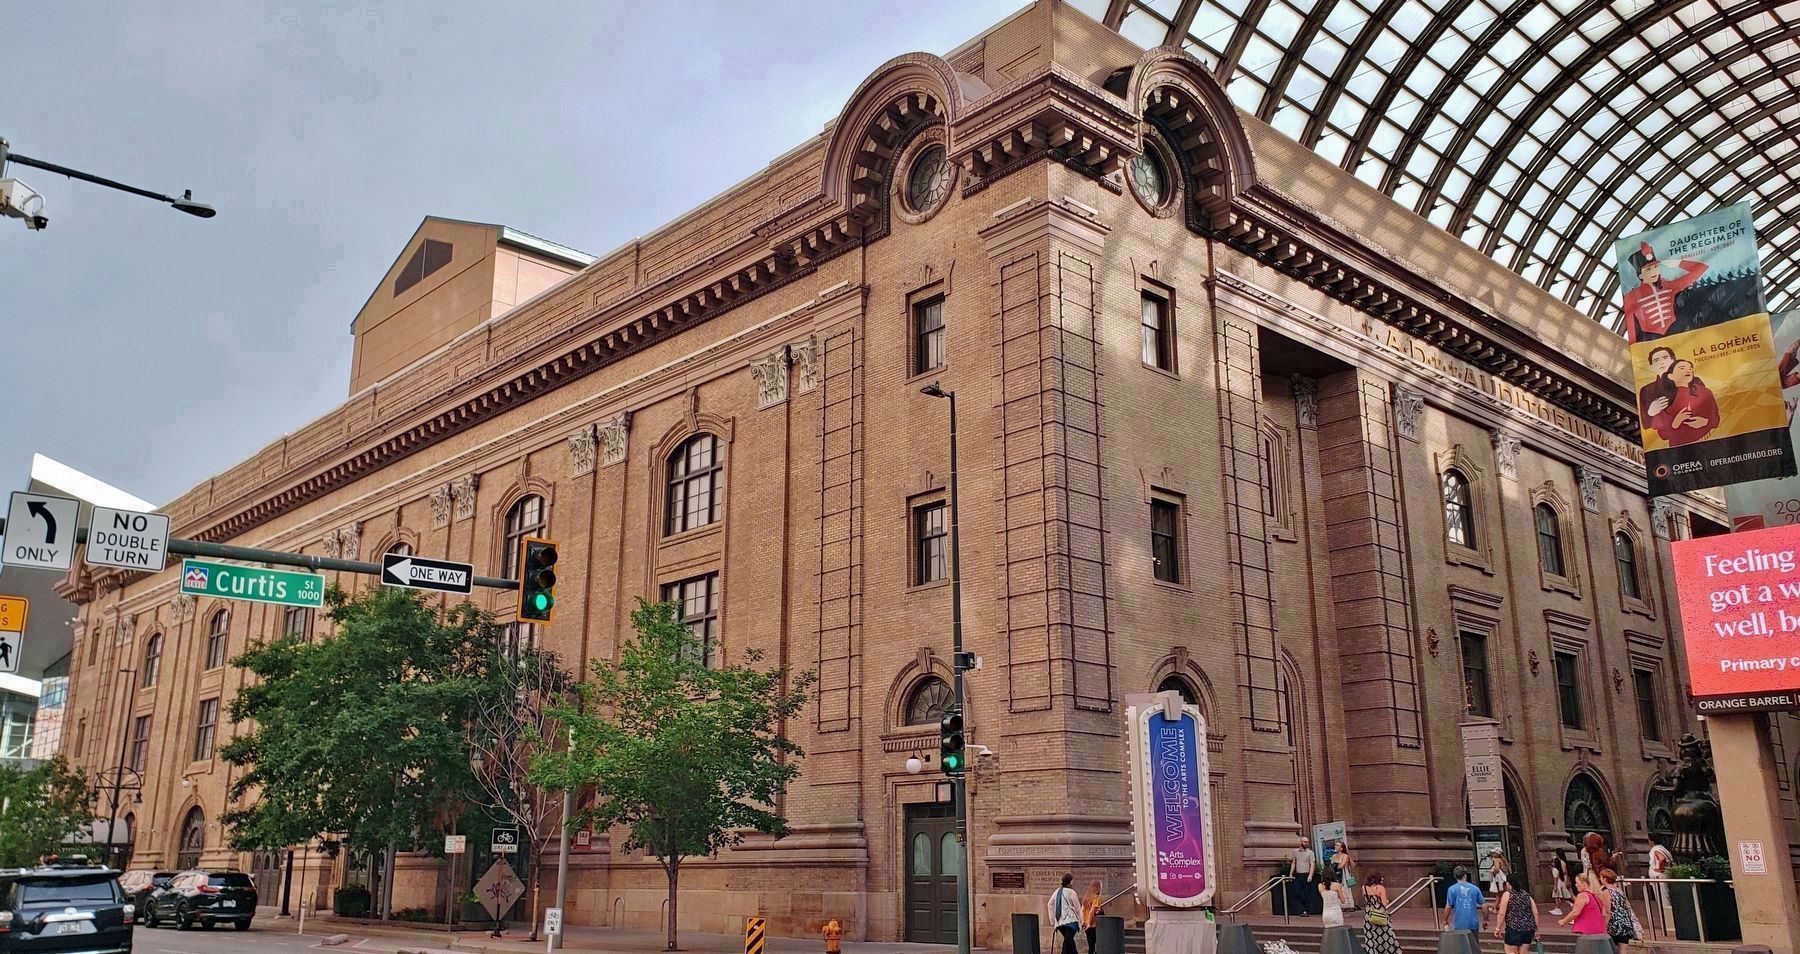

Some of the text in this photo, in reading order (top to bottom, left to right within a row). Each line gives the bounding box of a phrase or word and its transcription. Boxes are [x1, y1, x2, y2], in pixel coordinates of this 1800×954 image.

[1668, 227, 1746, 256] THE REGIMENT
[1669, 220, 1742, 248] DAUGHTER OF
[1692, 334, 1759, 356] LA BOHÈME
[1672, 448, 1782, 472] OPERA OPERACOLORADO.ORG
[1674, 466, 1703, 475] COLORADO
[112, 512, 148, 532] NO
[96, 532, 160, 552] DOUBLE
[16, 546, 59, 562] ONLY
[104, 548, 149, 566] TURN
[1704, 549, 1796, 577] Feeling
[216, 570, 314, 598] Curtis St
[410, 566, 463, 584] ONE WAY
[298, 590, 320, 600] 1000
[1709, 583, 1750, 613] got
[1758, 585, 1774, 603] a
[1714, 612, 1774, 638] well,
[1720, 656, 1787, 672] Primary
[1698, 698, 1747, 710] ORANGE
[1750, 695, 1793, 707] BARREL
[1160, 728, 1184, 842] WELCOME
[1183, 798, 1188, 808] TO
[1169, 850, 1184, 858] Arts
[1170, 858, 1201, 866] Complex
